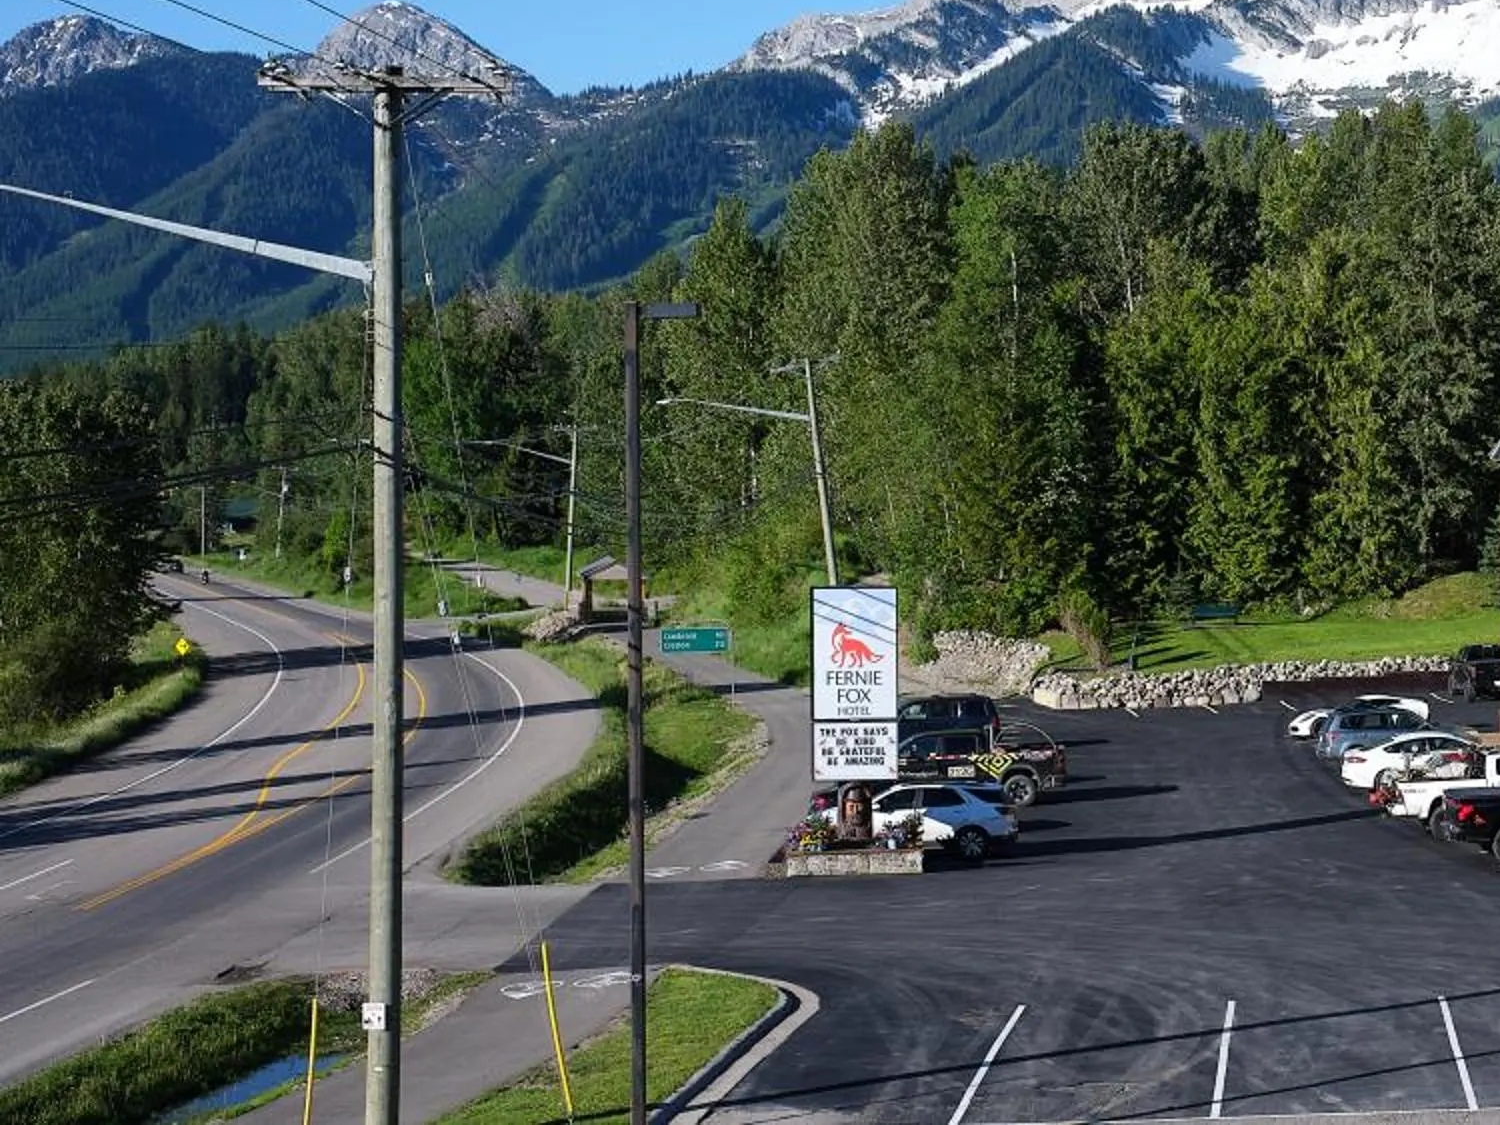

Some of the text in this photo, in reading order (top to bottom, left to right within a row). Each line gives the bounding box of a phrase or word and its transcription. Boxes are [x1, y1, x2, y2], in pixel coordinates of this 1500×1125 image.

[826, 670, 884, 686] FERNIE
[837, 688, 872, 704] FOX
[837, 706, 872, 716] HOTEL
